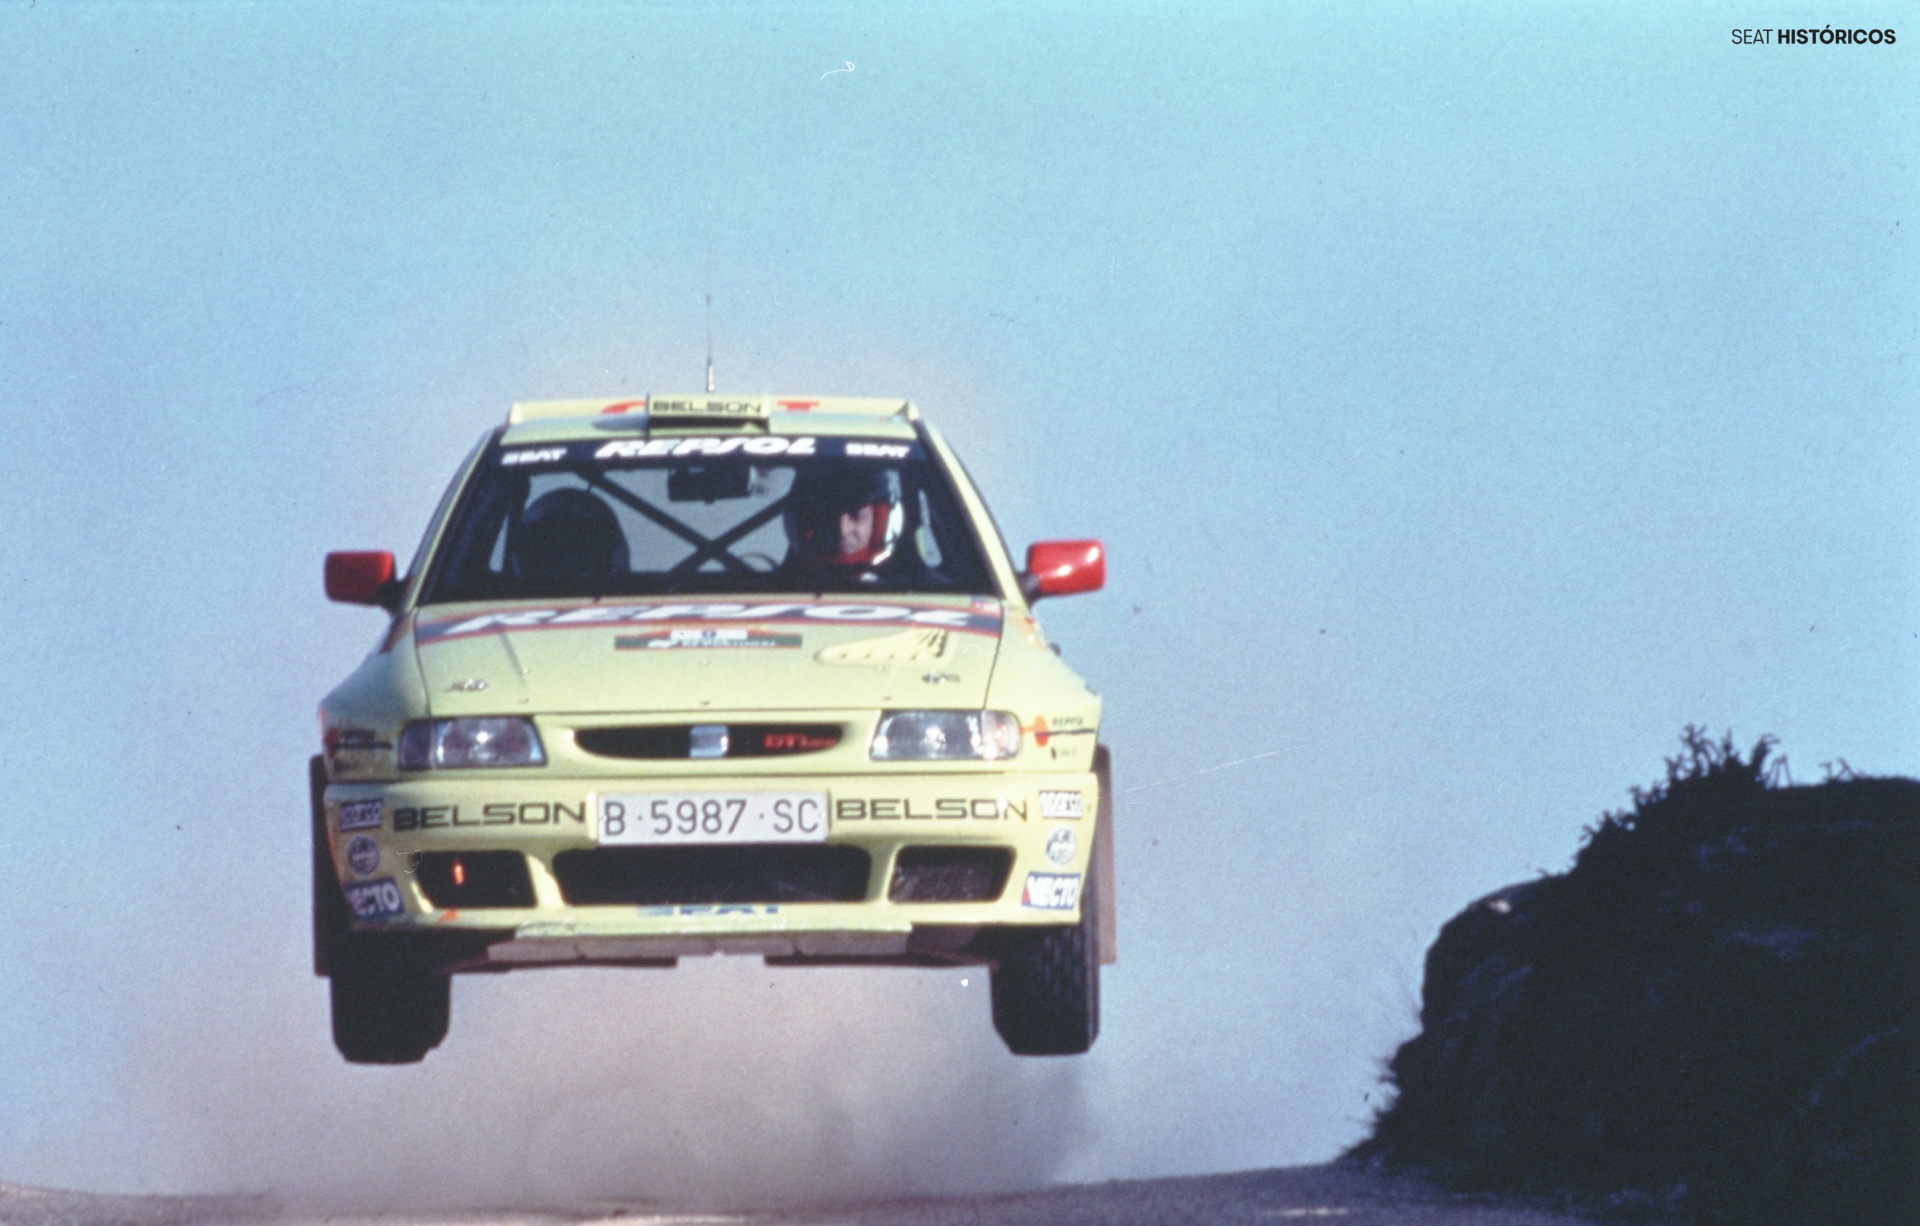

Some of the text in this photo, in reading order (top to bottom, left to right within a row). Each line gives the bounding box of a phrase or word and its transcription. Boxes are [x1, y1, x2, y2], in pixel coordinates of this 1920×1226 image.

[653, 401, 762, 413] BELSON
[501, 448, 567, 465] SEAT
[594, 436, 816, 459] REPSOL
[845, 442, 911, 459] SEAT
[393, 801, 587, 832] BELSON
[836, 798, 1027, 822] BELSON
